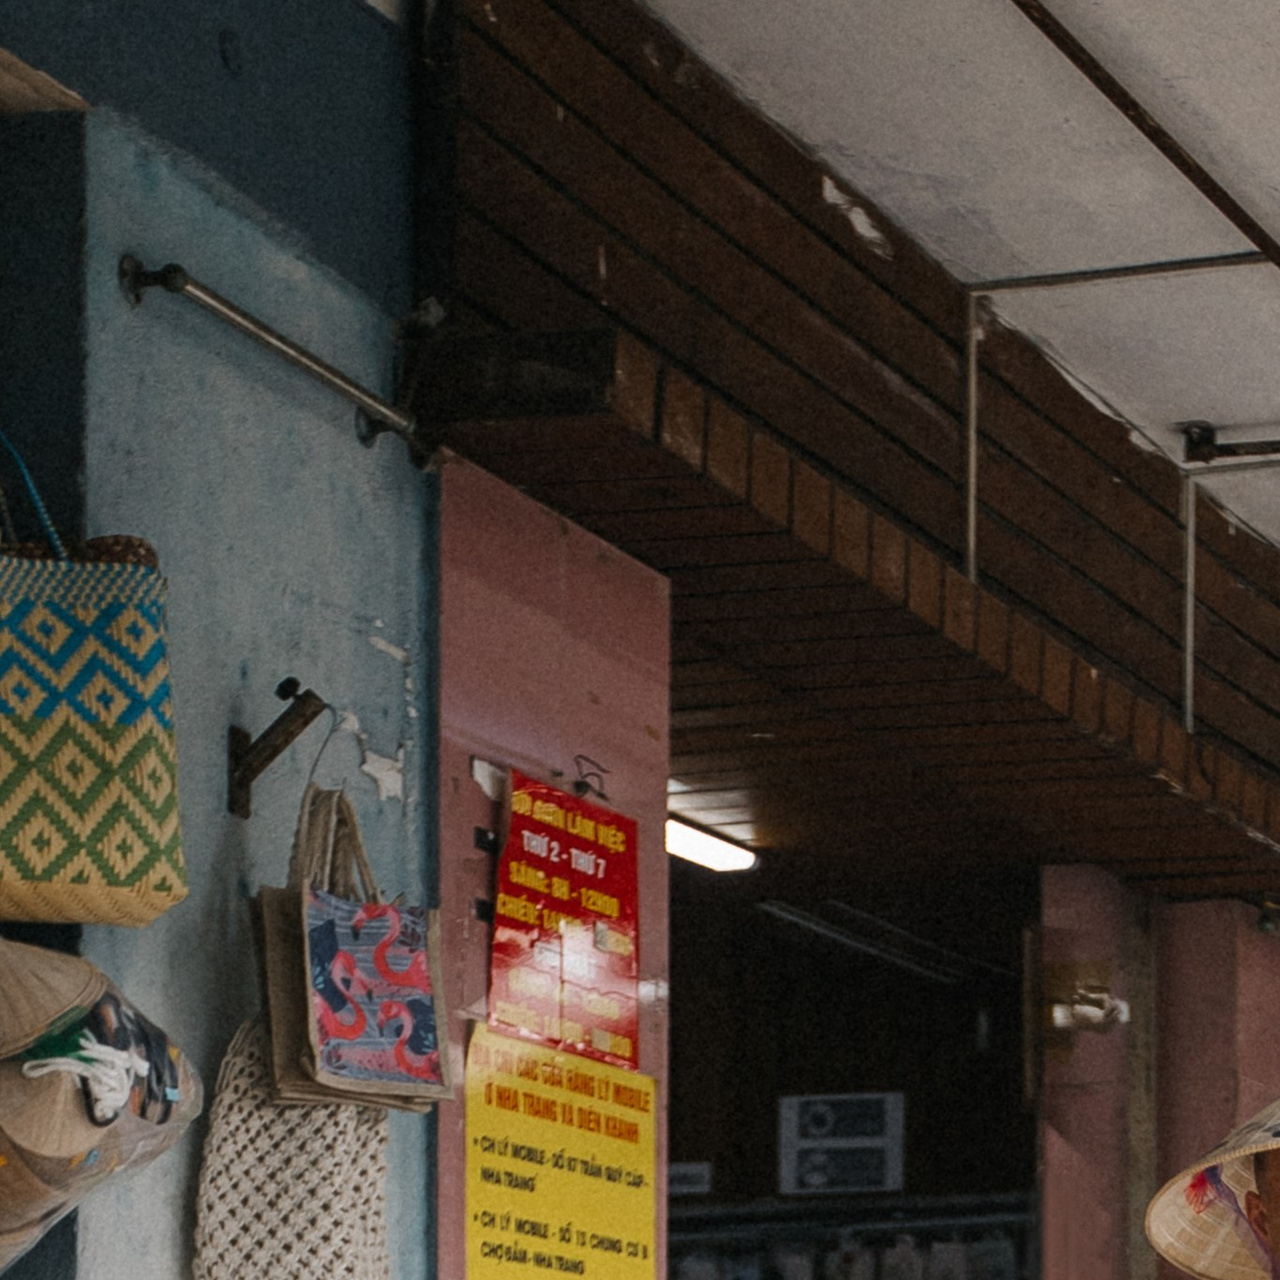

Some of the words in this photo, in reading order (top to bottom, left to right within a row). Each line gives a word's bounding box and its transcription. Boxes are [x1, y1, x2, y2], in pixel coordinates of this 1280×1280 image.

[550, 841, 560, 862] 2
[597, 859, 606, 879] 7
[497, 1086, 519, 1112] NHA
[524, 1093, 557, 1122] TRANG
[613, 1084, 650, 1113] MOBILE
[512, 1144, 546, 1165] MOBILE
[481, 1167, 501, 1185] NHA
[516, 1218, 549, 1240] MOBILE
[534, 1253, 553, 1269] NHA
[556, 1256, 585, 1276] TRANG
